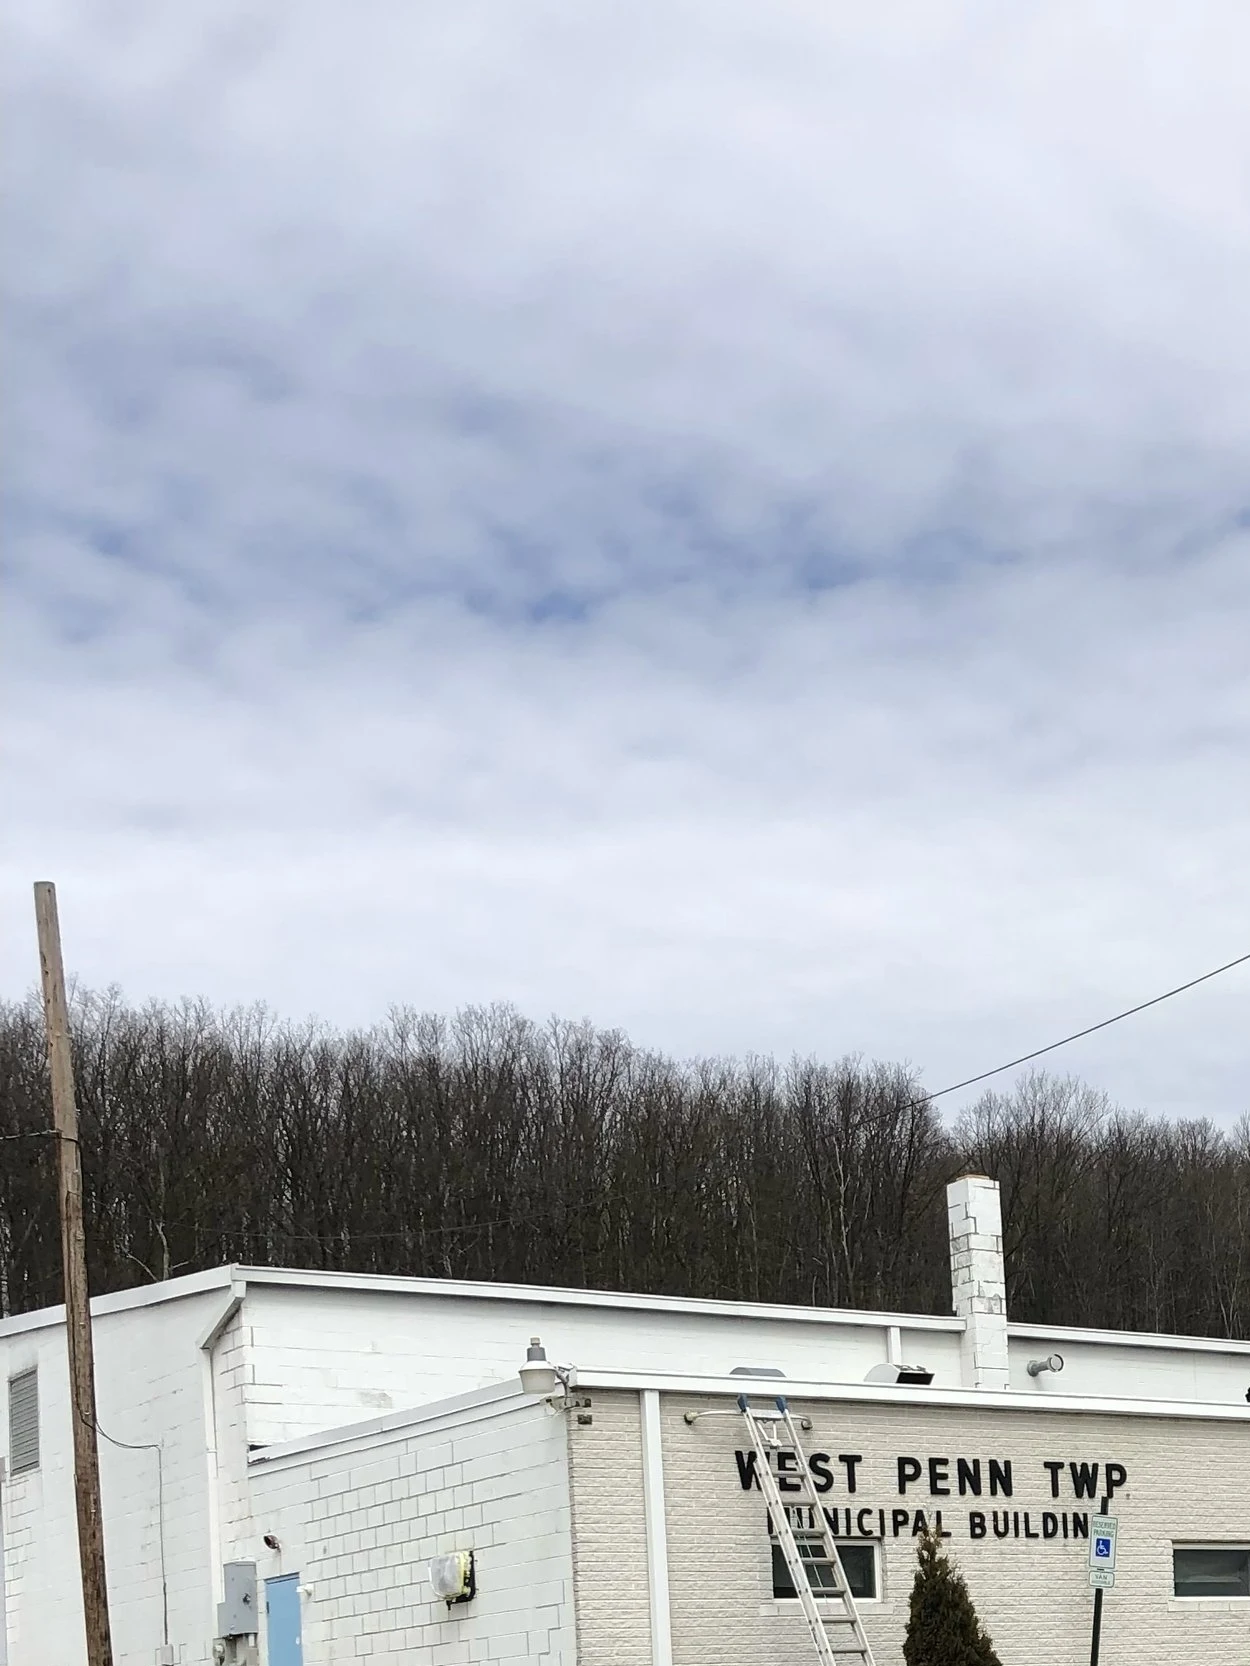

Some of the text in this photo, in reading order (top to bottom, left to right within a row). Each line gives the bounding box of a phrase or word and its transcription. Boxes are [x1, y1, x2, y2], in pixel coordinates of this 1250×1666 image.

[735, 1450, 1127, 1499] WEST PENN TWP
[970, 1511, 1089, 1539] BUILDIN
